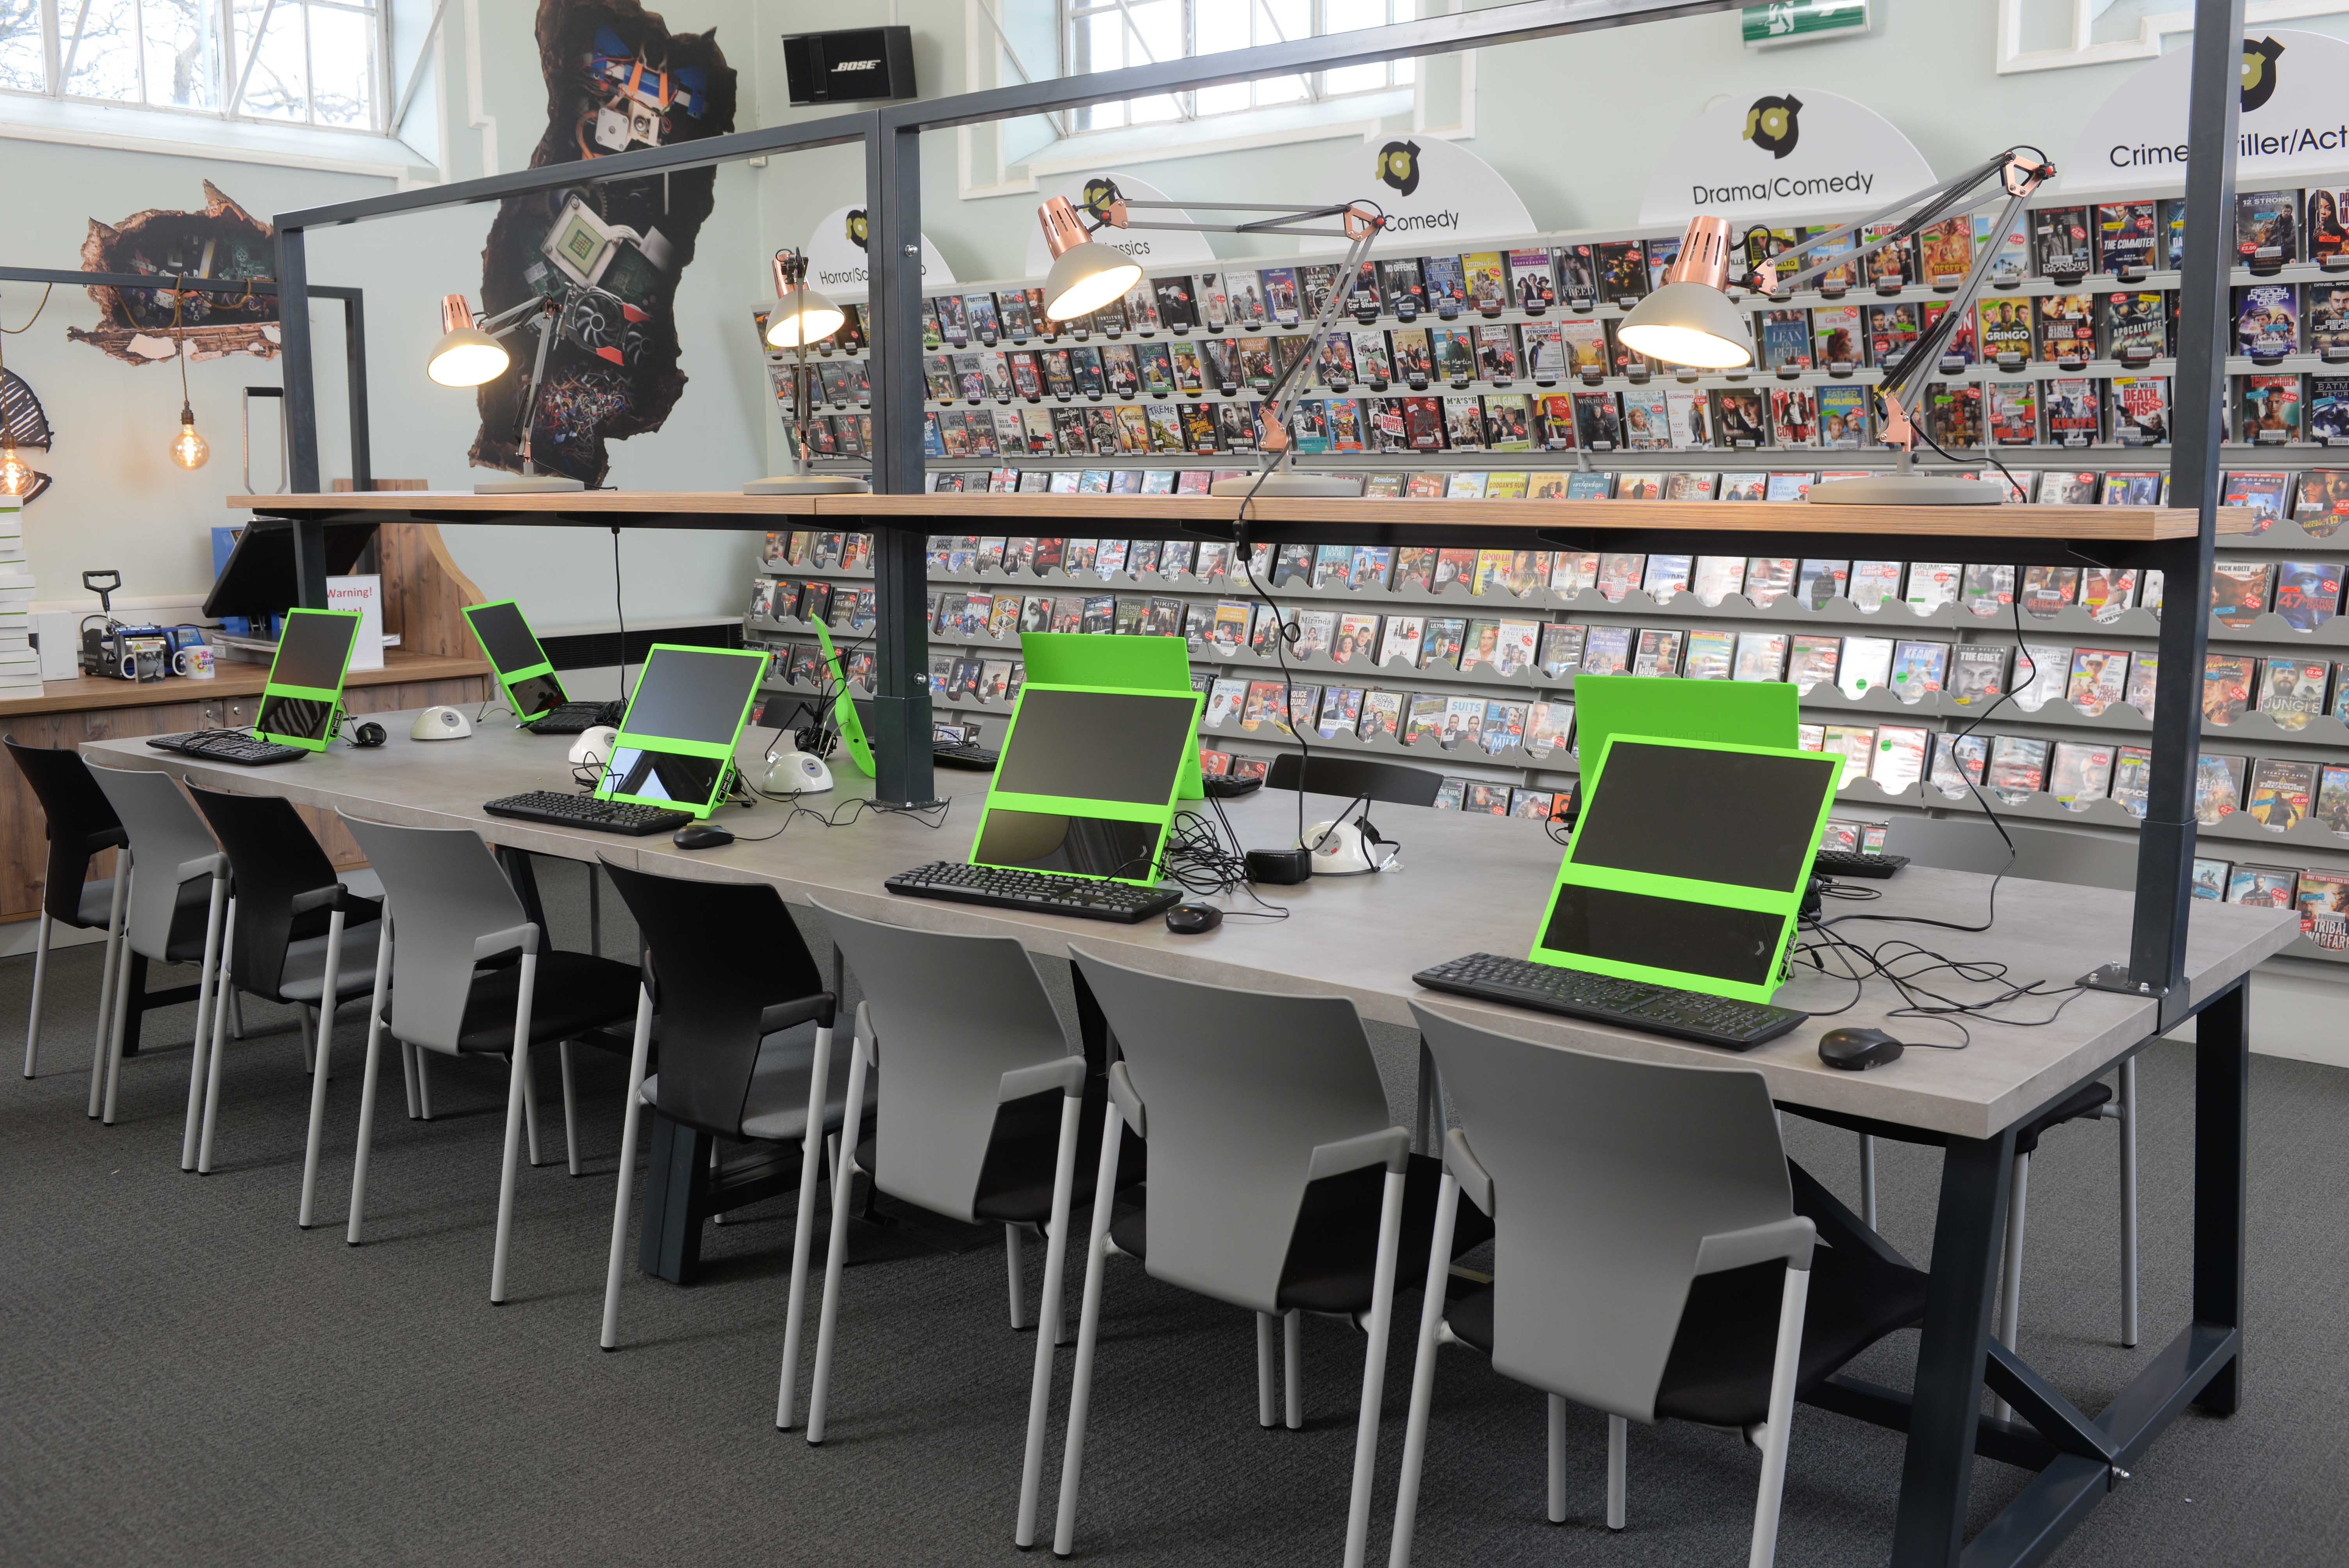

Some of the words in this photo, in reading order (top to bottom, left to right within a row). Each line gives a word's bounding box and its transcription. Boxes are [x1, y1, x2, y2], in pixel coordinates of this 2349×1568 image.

[831, 59, 881, 72] BOSE
[1693, 171, 1873, 205] Drama/Comedy
[1384, 210, 1458, 232] Comedy
[2105, 240, 2116, 250] THE
[2117, 237, 2155, 249] COMMUTER
[1393, 262, 1417, 272] OFFENCE
[1934, 265, 1964, 273] DESERT
[1563, 287, 1594, 297] FREED
[968, 295, 989, 304] FORTITUDE
[2114, 321, 2161, 337] APOCALYPSE
[1772, 330, 1802, 343] LEAN
[1986, 331, 2028, 340] GRINGO
[2124, 389, 2157, 402] DEATH
[1485, 396, 1500, 406] STILL
[1502, 396, 1522, 406] GAME
[1578, 397, 1615, 405] WINCHESTER
[1068, 409, 1078, 417] Girls
[1149, 406, 1174, 415] TREME
[1383, 416, 1403, 425] FRANKIE
[2052, 418, 2096, 429] KRAYS
[1383, 422, 1403, 432] BOYLE'S
[1777, 426, 1793, 437] CON
[1800, 426, 1816, 437] MAN
[2323, 582, 2337, 590] £2.00
[327, 587, 372, 598] Warning!
[2279, 593, 2304, 608] 47
[1300, 616, 1331, 625] Miranda
[1904, 648, 1939, 660] KEANU
[1961, 652, 1973, 661] THE
[1975, 653, 2001, 662] GREY
[1638, 666, 1657, 675] LOVE
[1374, 700, 1395, 709] CHIPS
[1452, 701, 1481, 712] SUITS
[2264, 698, 2319, 714] JUNGLE
[2314, 920, 2347, 935] TRIBAL
